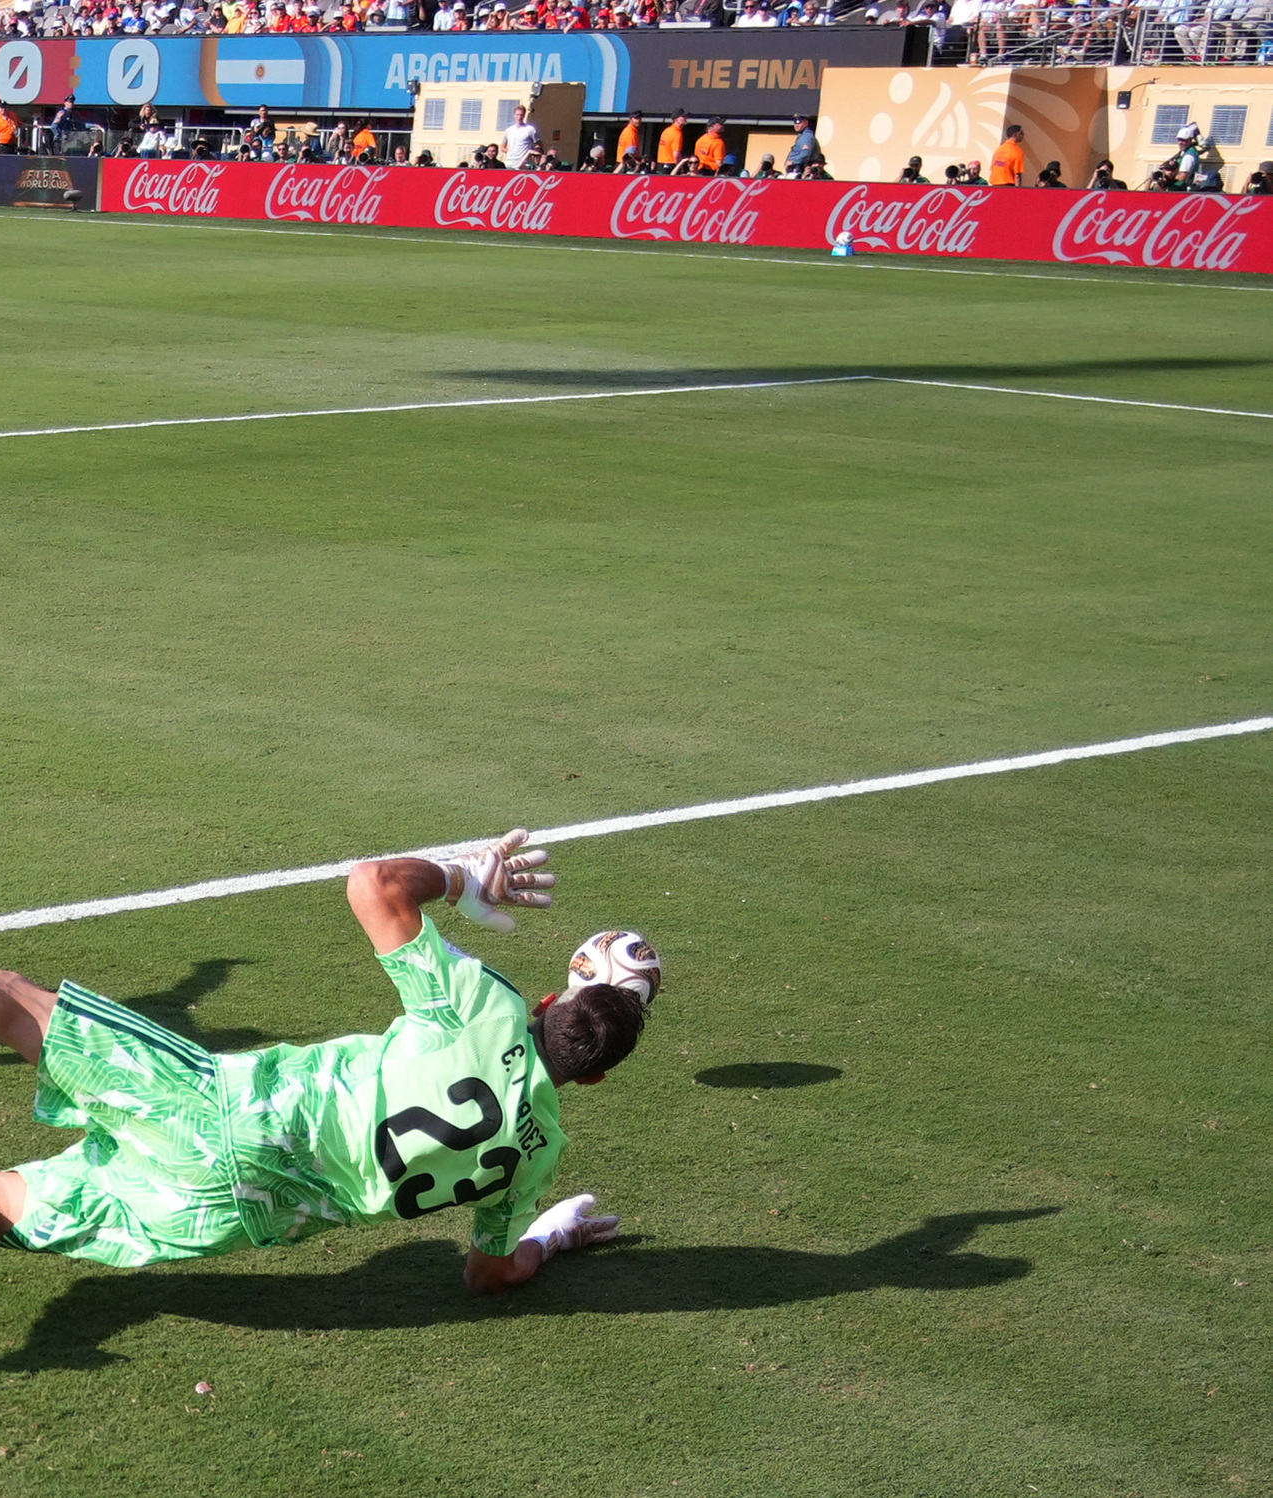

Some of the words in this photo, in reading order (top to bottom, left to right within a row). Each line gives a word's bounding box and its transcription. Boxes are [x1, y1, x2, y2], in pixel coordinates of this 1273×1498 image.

[107, 39, 161, 105] 0
[384, 52, 563, 90] ARGENTINA
[668, 59, 733, 89] THE
[27, 169, 61, 180] FIFA
[124, 161, 226, 213] Coca-Cola
[264, 163, 390, 224] Coca-Cola
[434, 171, 564, 230] Coca-Cola
[610, 176, 768, 243] Coca-Cola
[825, 184, 993, 253] Coca-Cola
[1052, 190, 1264, 269] Coca-Cola
[374, 1076, 522, 1220] 23
